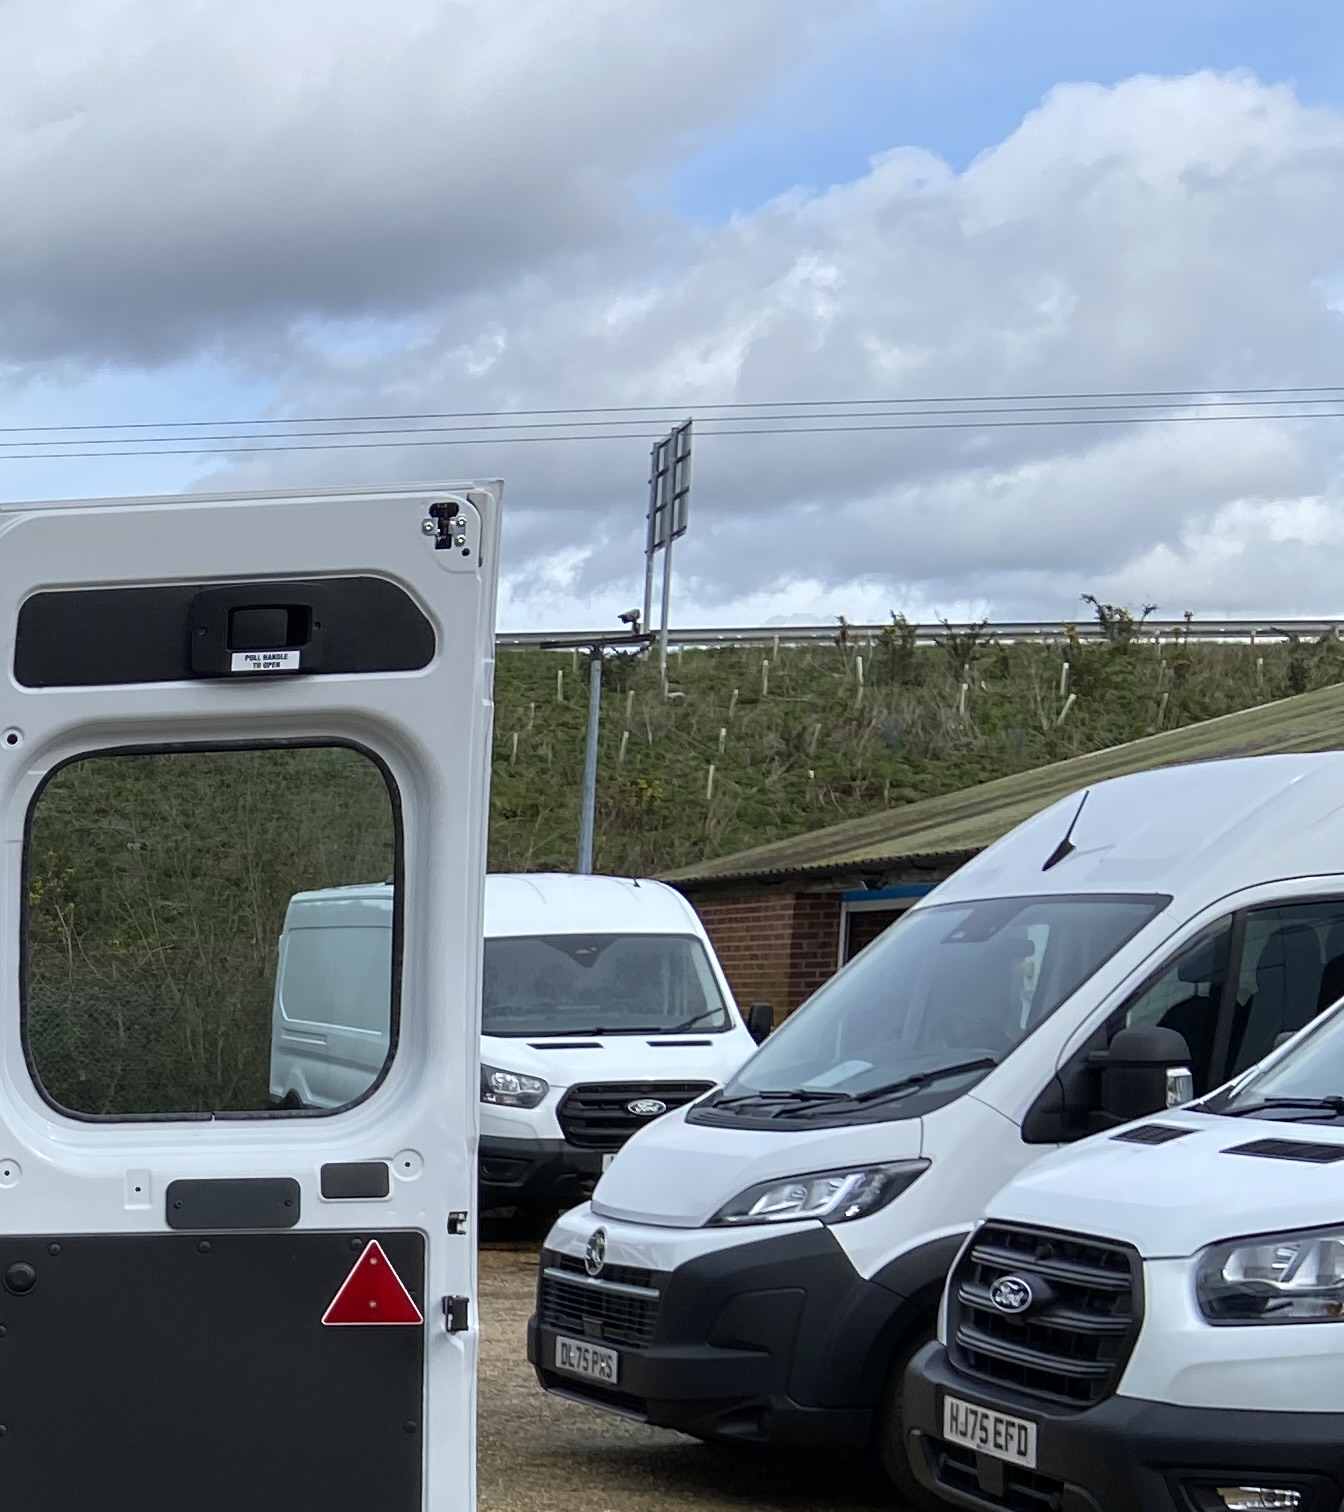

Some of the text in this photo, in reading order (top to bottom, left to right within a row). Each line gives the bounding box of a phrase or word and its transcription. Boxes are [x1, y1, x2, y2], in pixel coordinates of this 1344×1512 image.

[995, 1281, 1025, 1307] Ford
[561, 1342, 589, 1371] DL75
[950, 1401, 1028, 1457] HJ75 EFD
